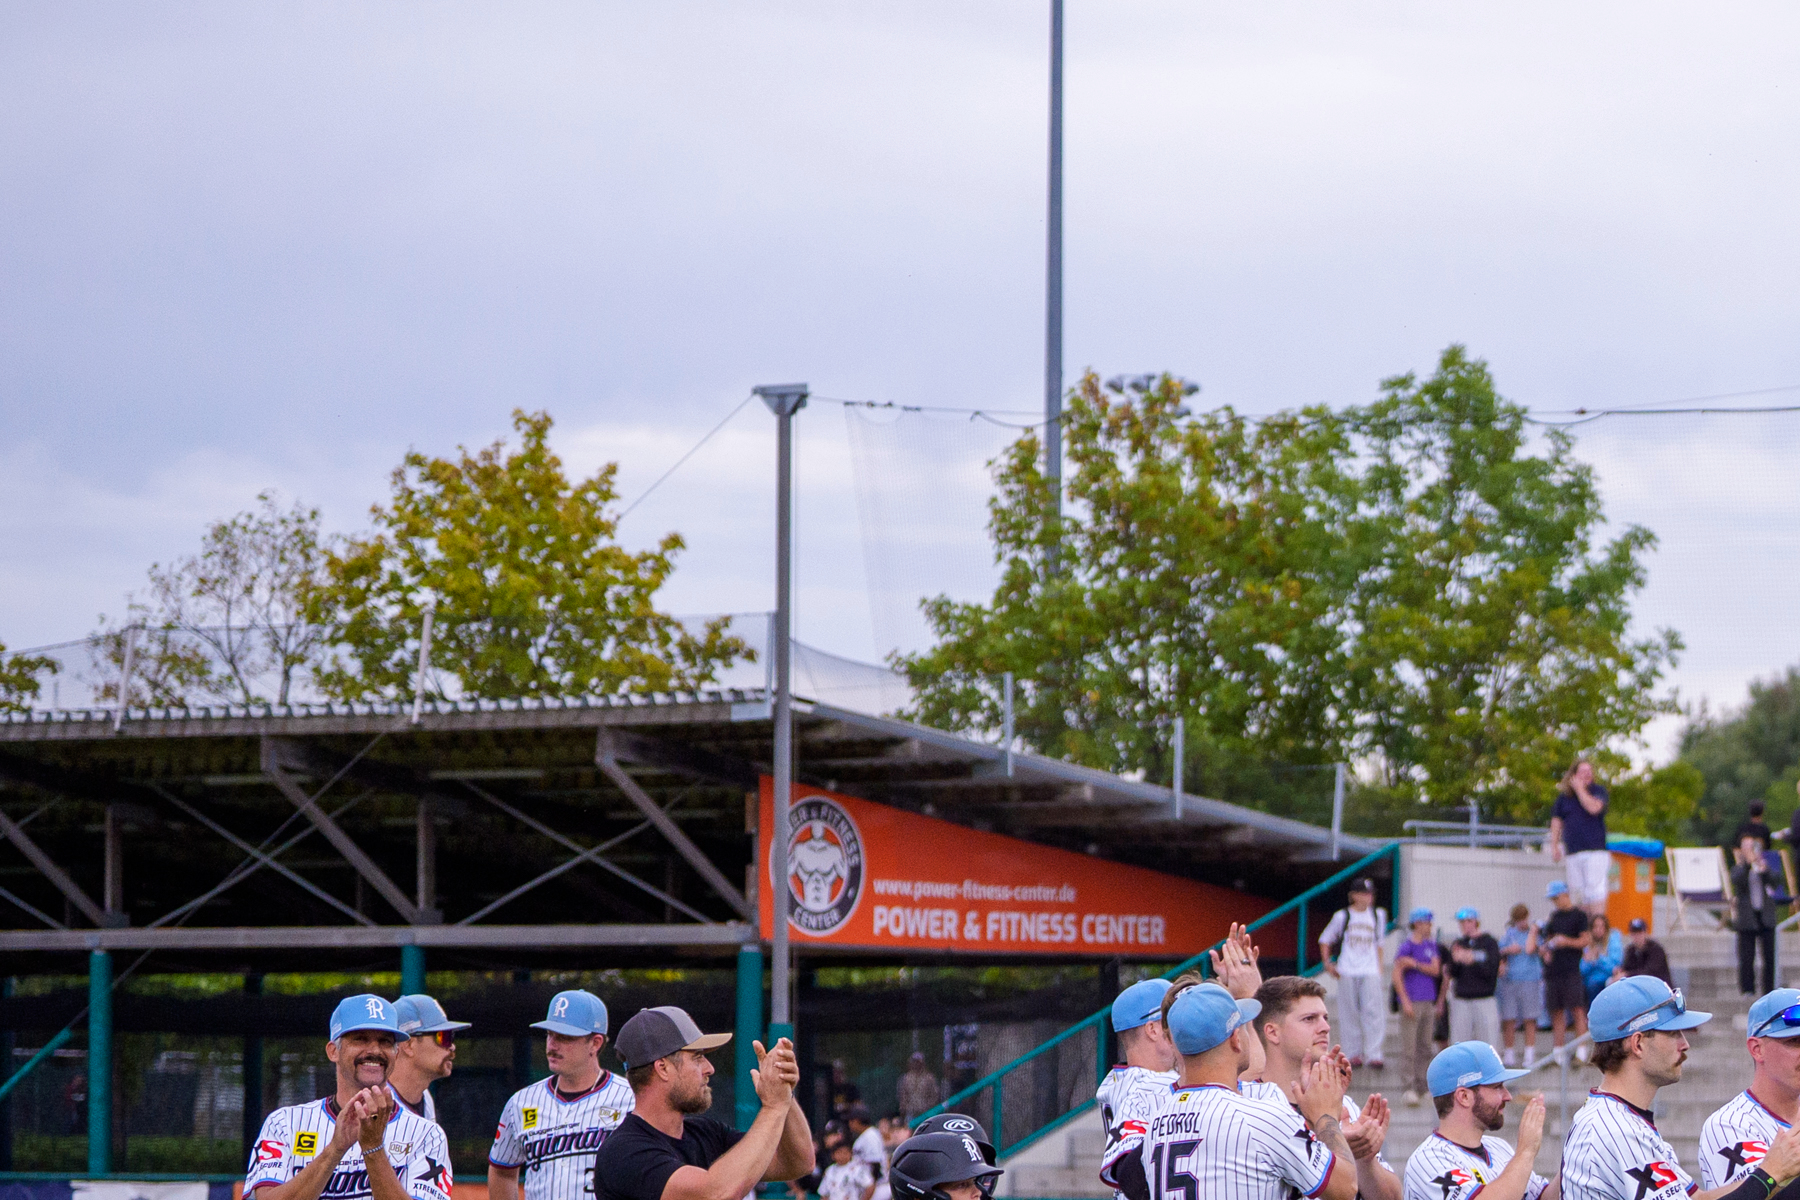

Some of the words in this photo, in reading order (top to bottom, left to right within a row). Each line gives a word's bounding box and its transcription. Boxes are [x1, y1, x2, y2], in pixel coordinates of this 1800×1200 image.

[873, 878, 1077, 903] www.power-fitness-center.de
[793, 903, 841, 930] CENTER
[873, 905, 959, 939] POWER
[963, 911, 981, 941] &
[986, 911, 1077, 943] FITNESS
[1082, 913, 1166, 945] CENTER
[365, 997, 386, 1021] R
[552, 997, 569, 1018] R
[1151, 1111, 1200, 1140] PEDROL
[962, 1137, 982, 1162] R
[413, 1182, 438, 1198] XTREME
